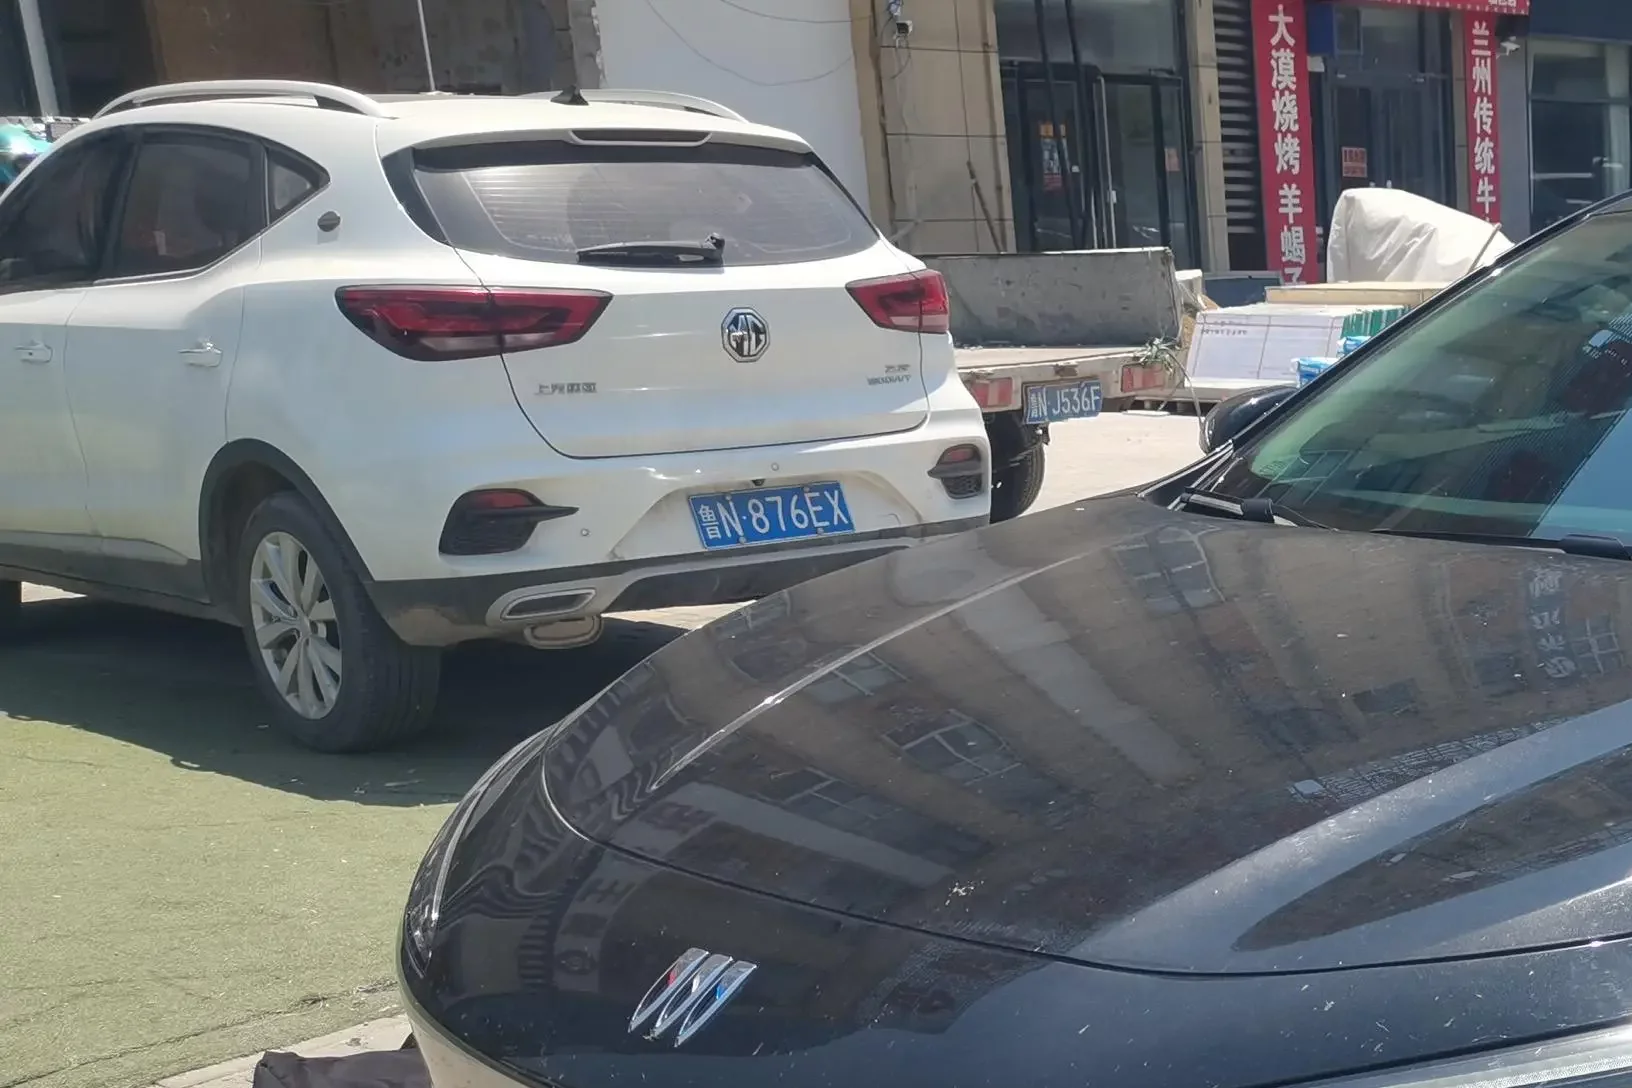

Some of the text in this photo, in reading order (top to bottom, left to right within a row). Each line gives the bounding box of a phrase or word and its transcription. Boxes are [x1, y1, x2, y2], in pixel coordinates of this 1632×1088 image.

[1268, 4, 1306, 286] 大漠烧烤 羊蝎子
[1471, 21, 1497, 224] 兰州传统牛
[726, 310, 767, 358] MG
